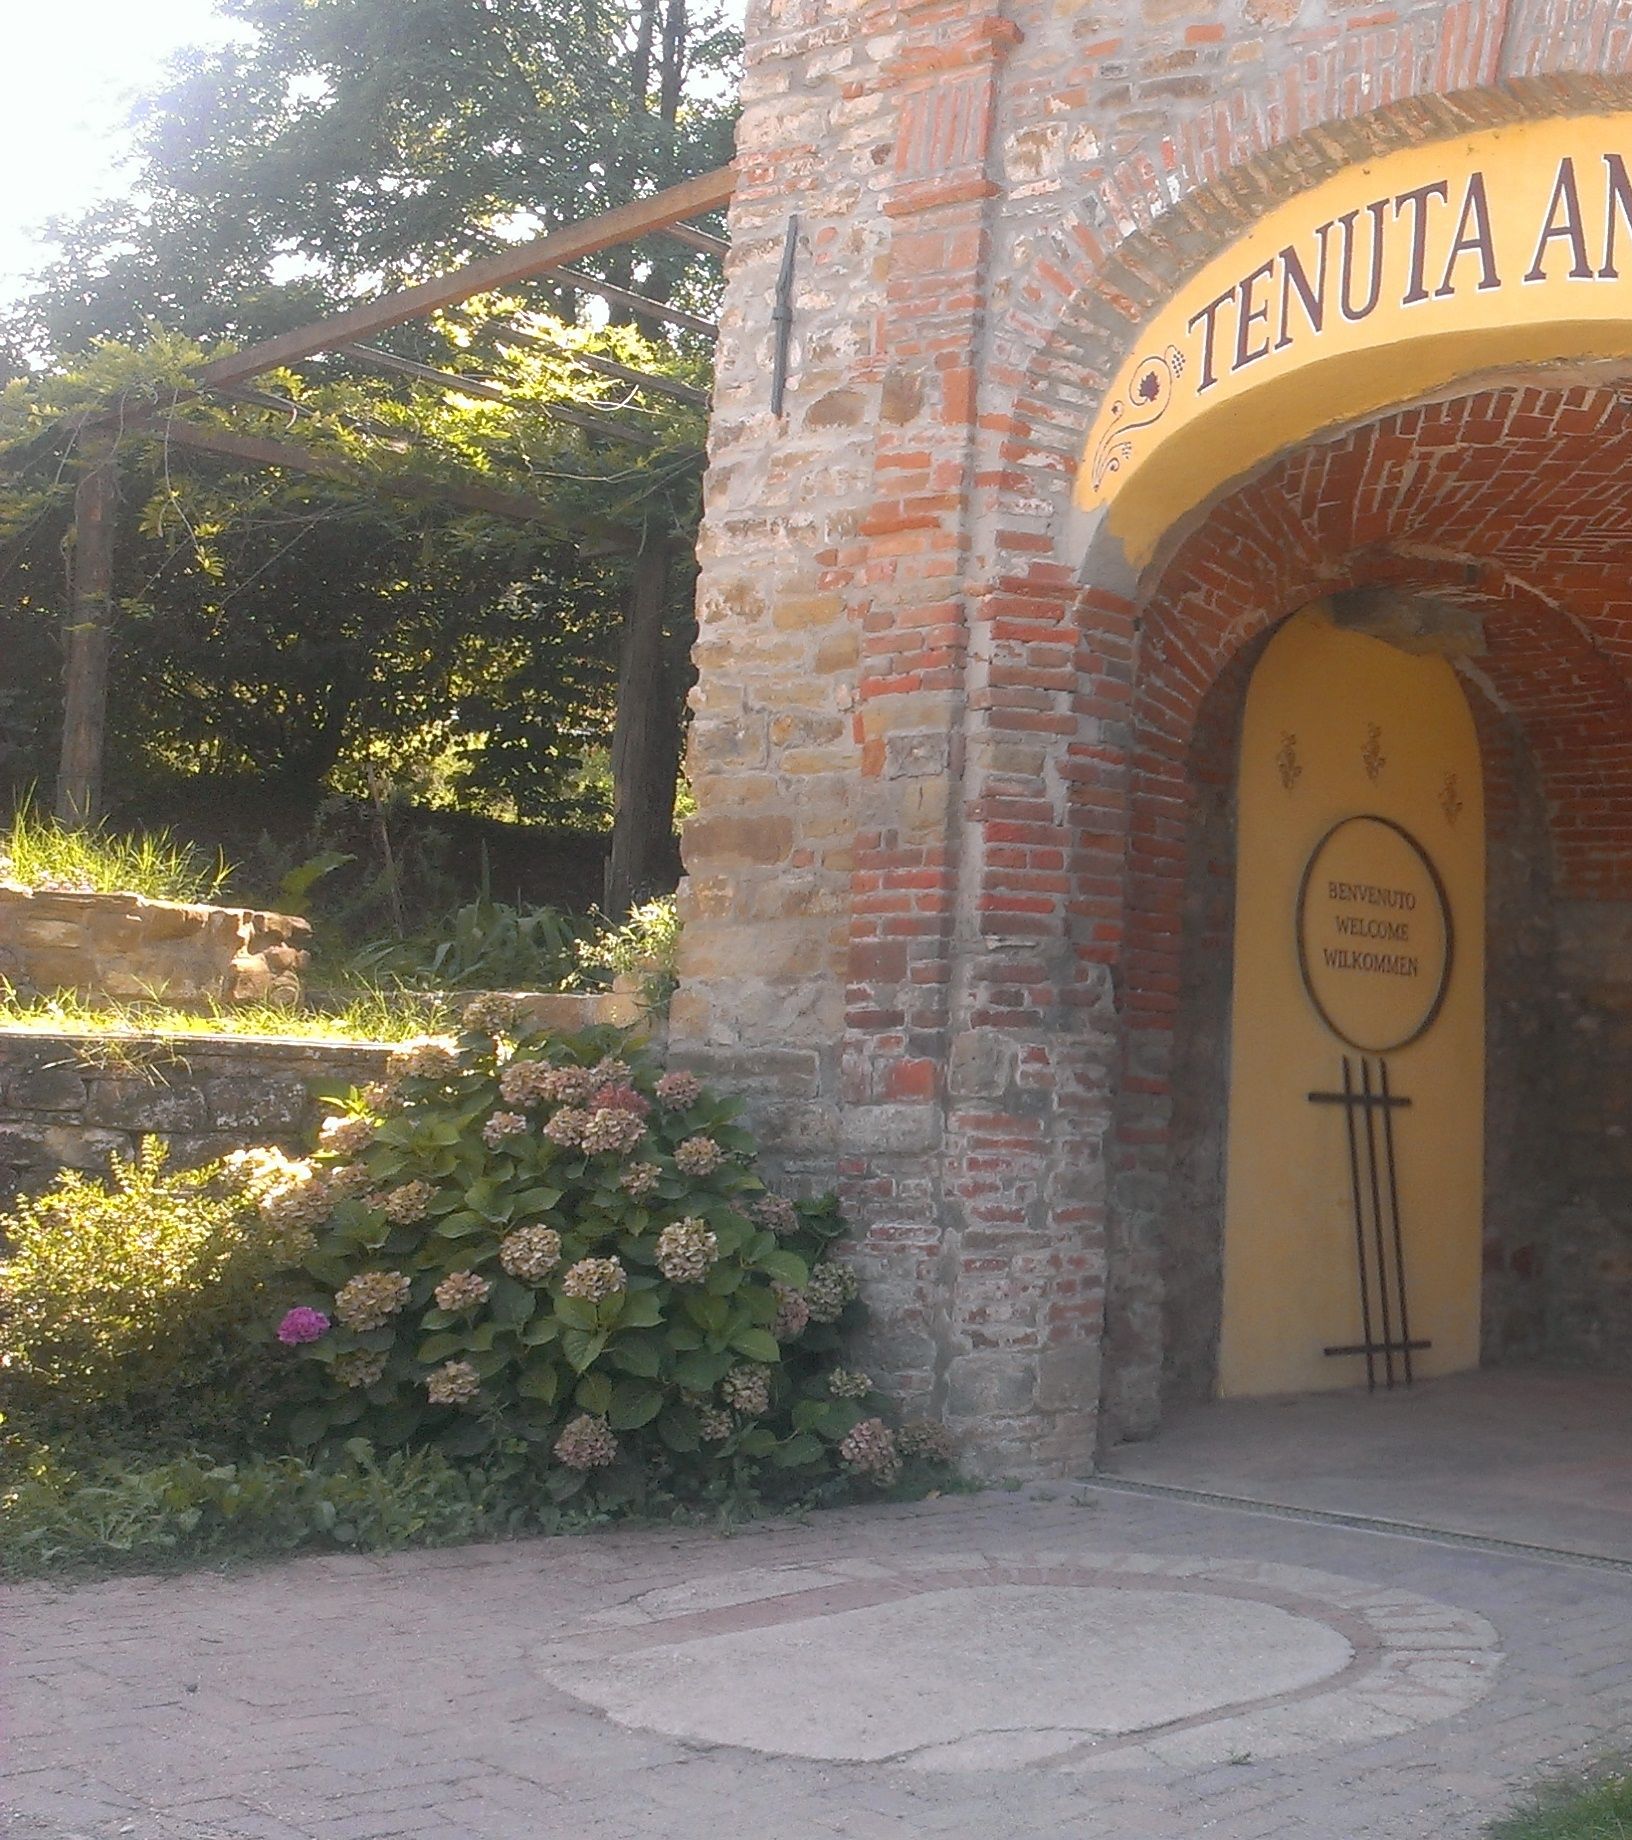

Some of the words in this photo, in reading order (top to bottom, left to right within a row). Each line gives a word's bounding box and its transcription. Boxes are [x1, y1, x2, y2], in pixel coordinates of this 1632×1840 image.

[1187, 171, 1502, 395] TENUTA
[1328, 881, 1416, 911] BENVENUTO
[1335, 915, 1409, 941] WELCOME
